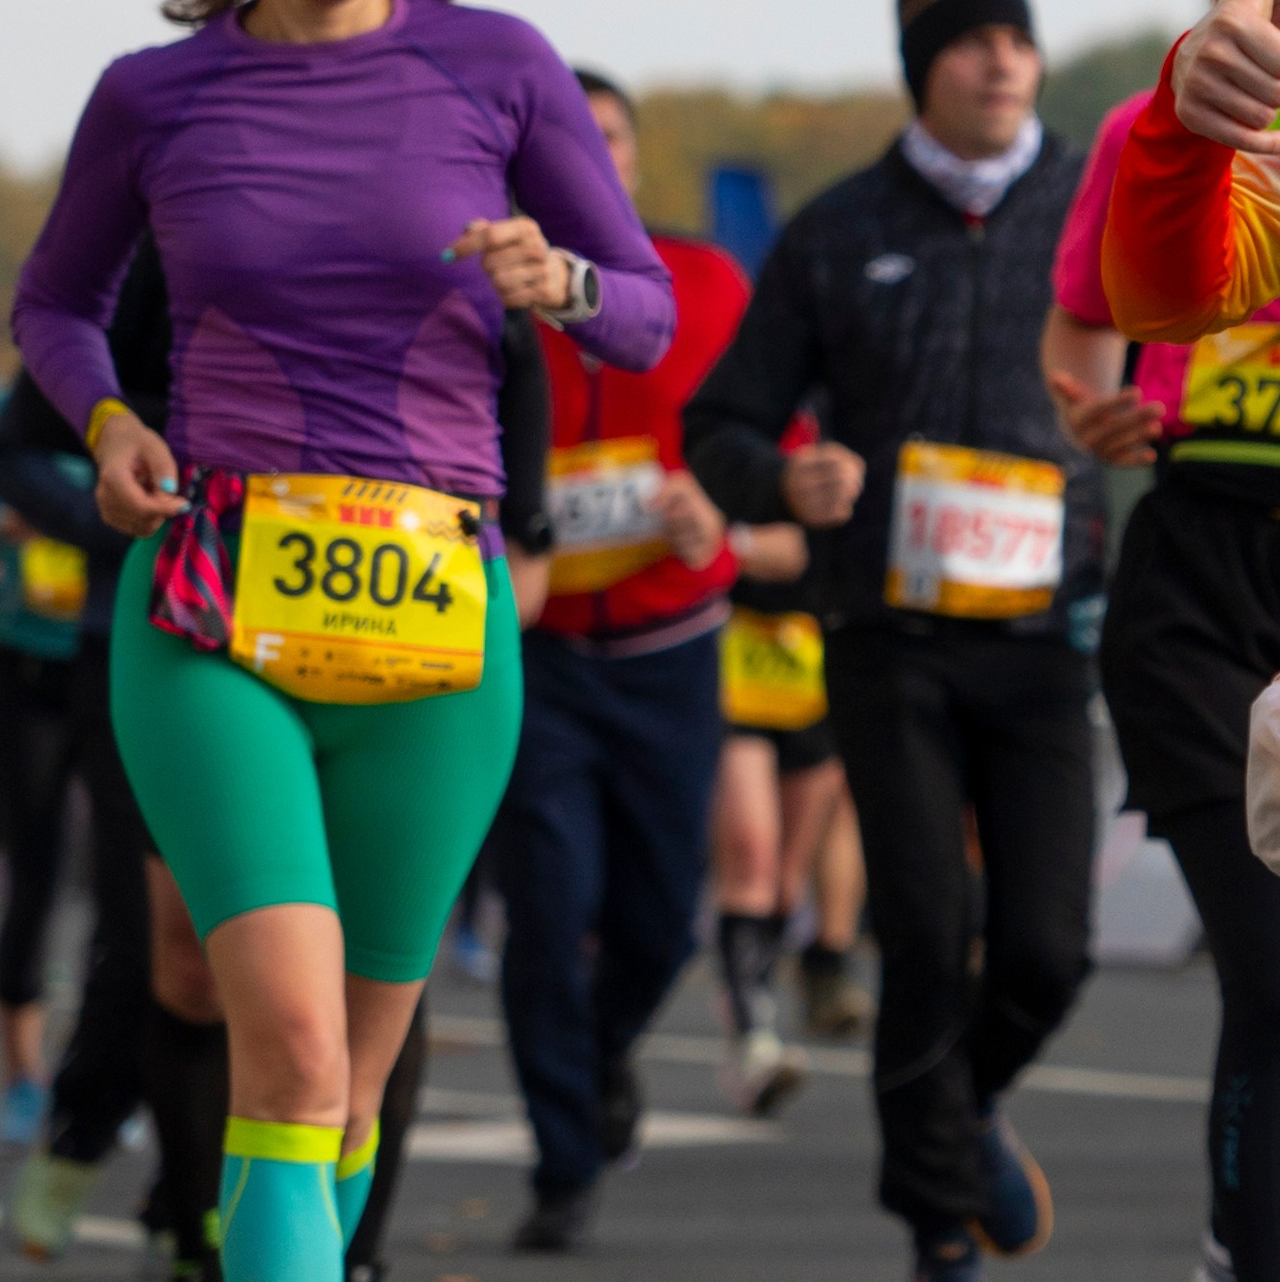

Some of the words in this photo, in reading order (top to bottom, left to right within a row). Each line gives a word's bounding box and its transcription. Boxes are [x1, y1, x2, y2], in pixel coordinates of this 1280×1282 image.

[274, 531, 453, 614] 3804
[322, 610, 398, 636] ИРИНА
[253, 632, 286, 673] F
